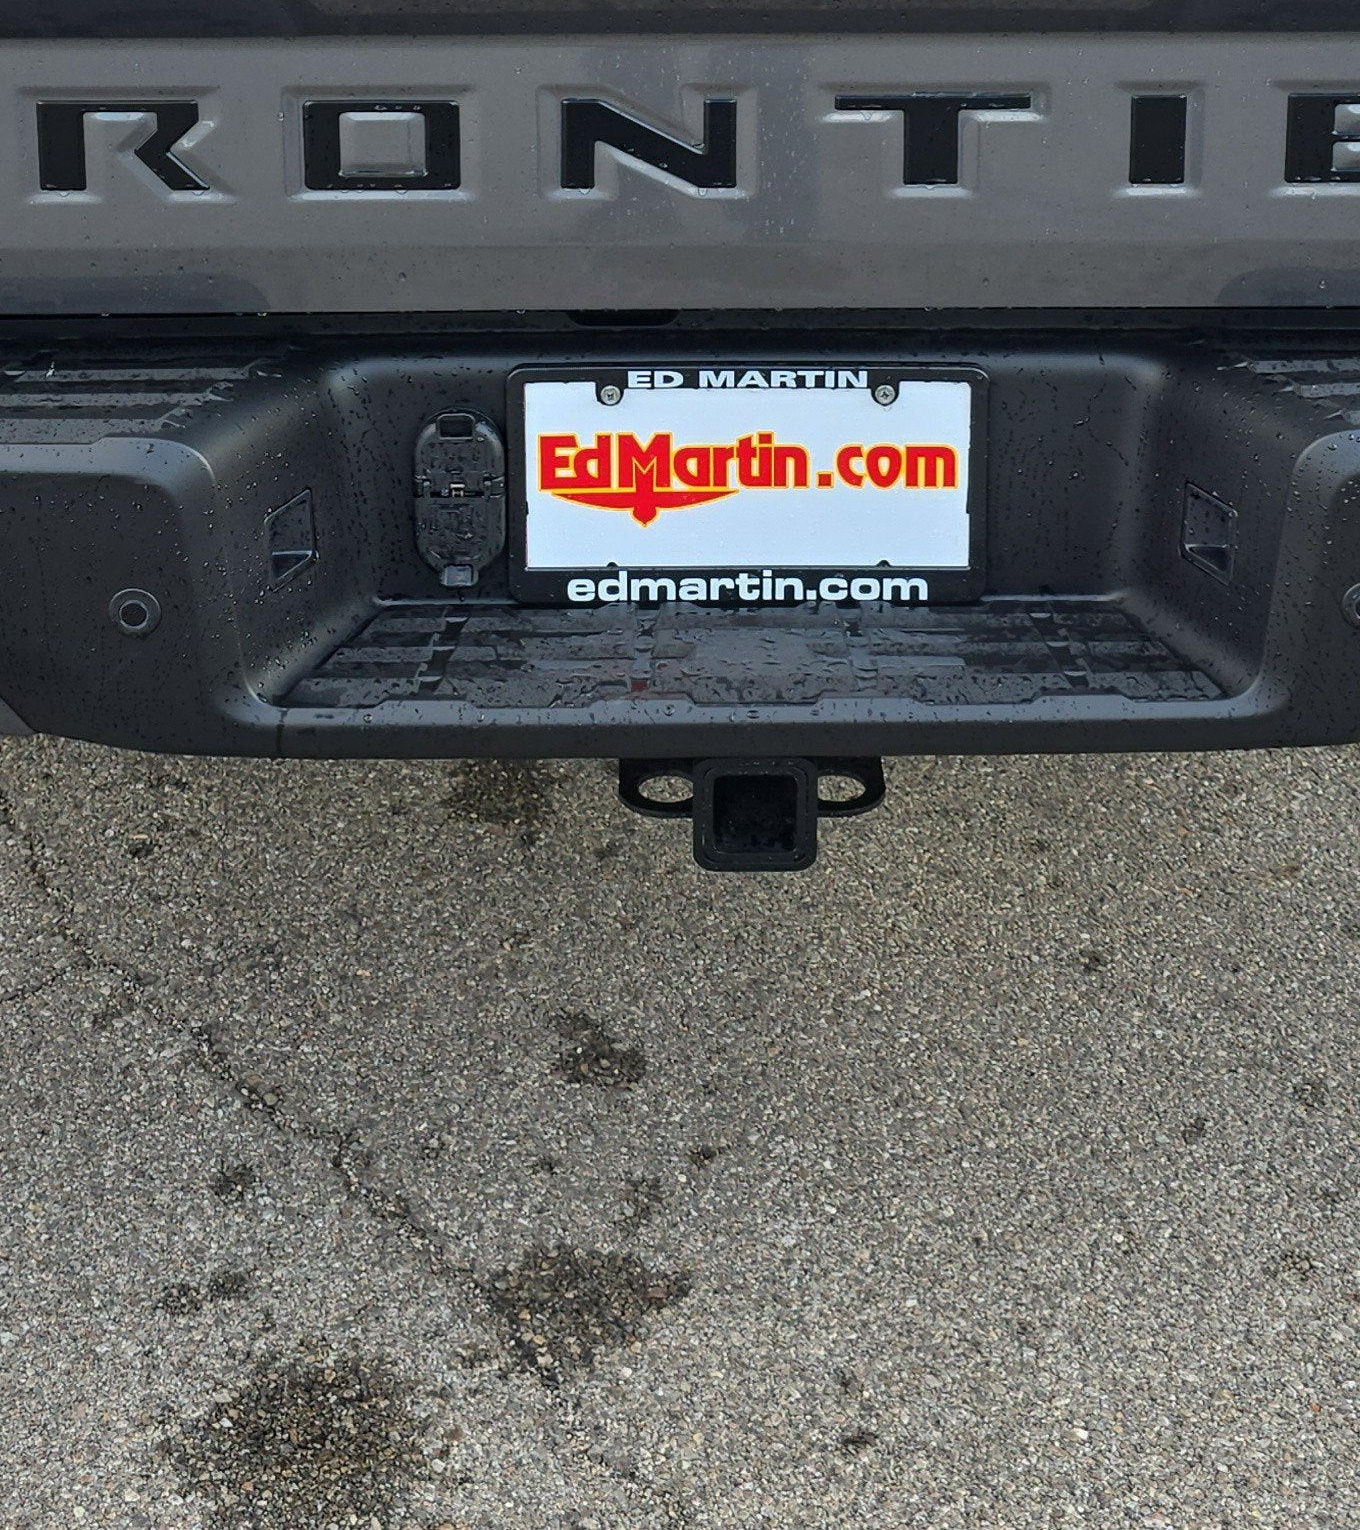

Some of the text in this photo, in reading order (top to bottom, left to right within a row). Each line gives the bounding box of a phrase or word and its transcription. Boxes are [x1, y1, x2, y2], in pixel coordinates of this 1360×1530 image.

[627, 370, 869, 389] ED MARTIN
[538, 430, 960, 491] EdMartin.com
[567, 570, 928, 602] edmartin.com
